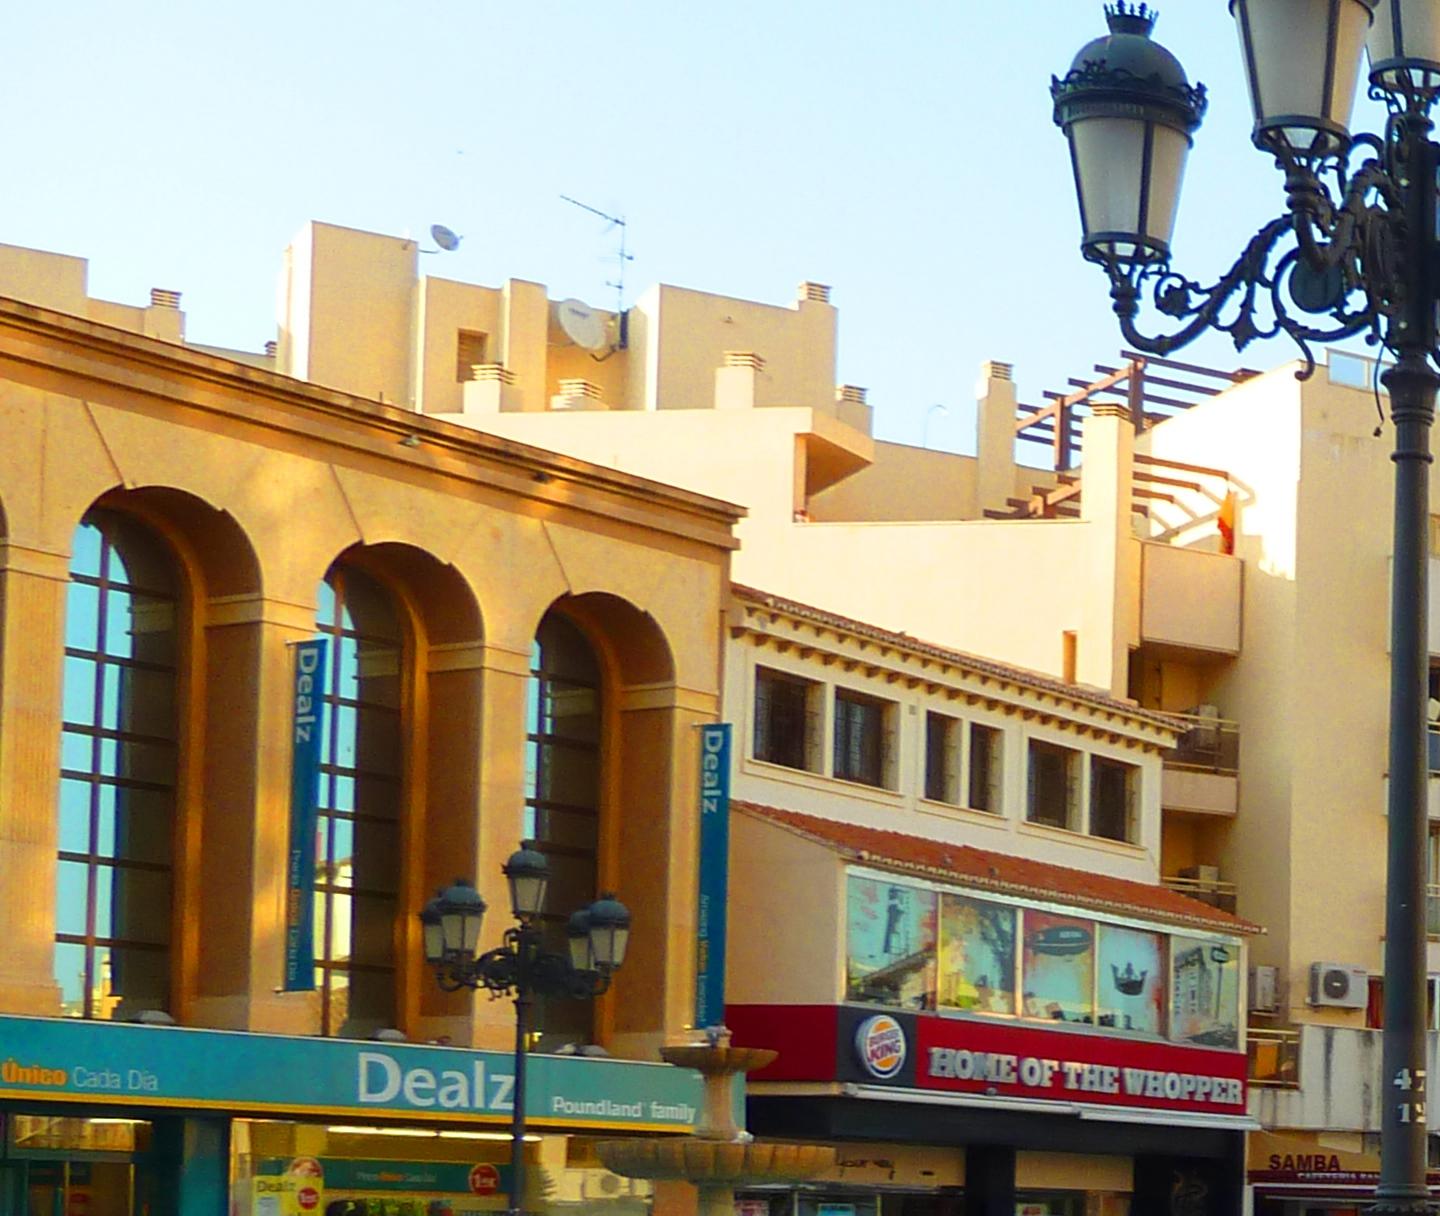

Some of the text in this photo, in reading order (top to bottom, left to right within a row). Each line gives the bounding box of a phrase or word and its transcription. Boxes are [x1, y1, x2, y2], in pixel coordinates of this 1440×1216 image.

[295, 647, 319, 744] Dealz
[702, 730, 724, 814] Dealz
[868, 1040, 900, 1062] KING
[72, 1065, 121, 1089] Cada
[358, 1052, 515, 1110] Dealz
[929, 1047, 1244, 1105] HOME OF THE WHOPPER
[553, 1096, 697, 1124] Poundland family
[1269, 1154, 1341, 1171] SAMBA
